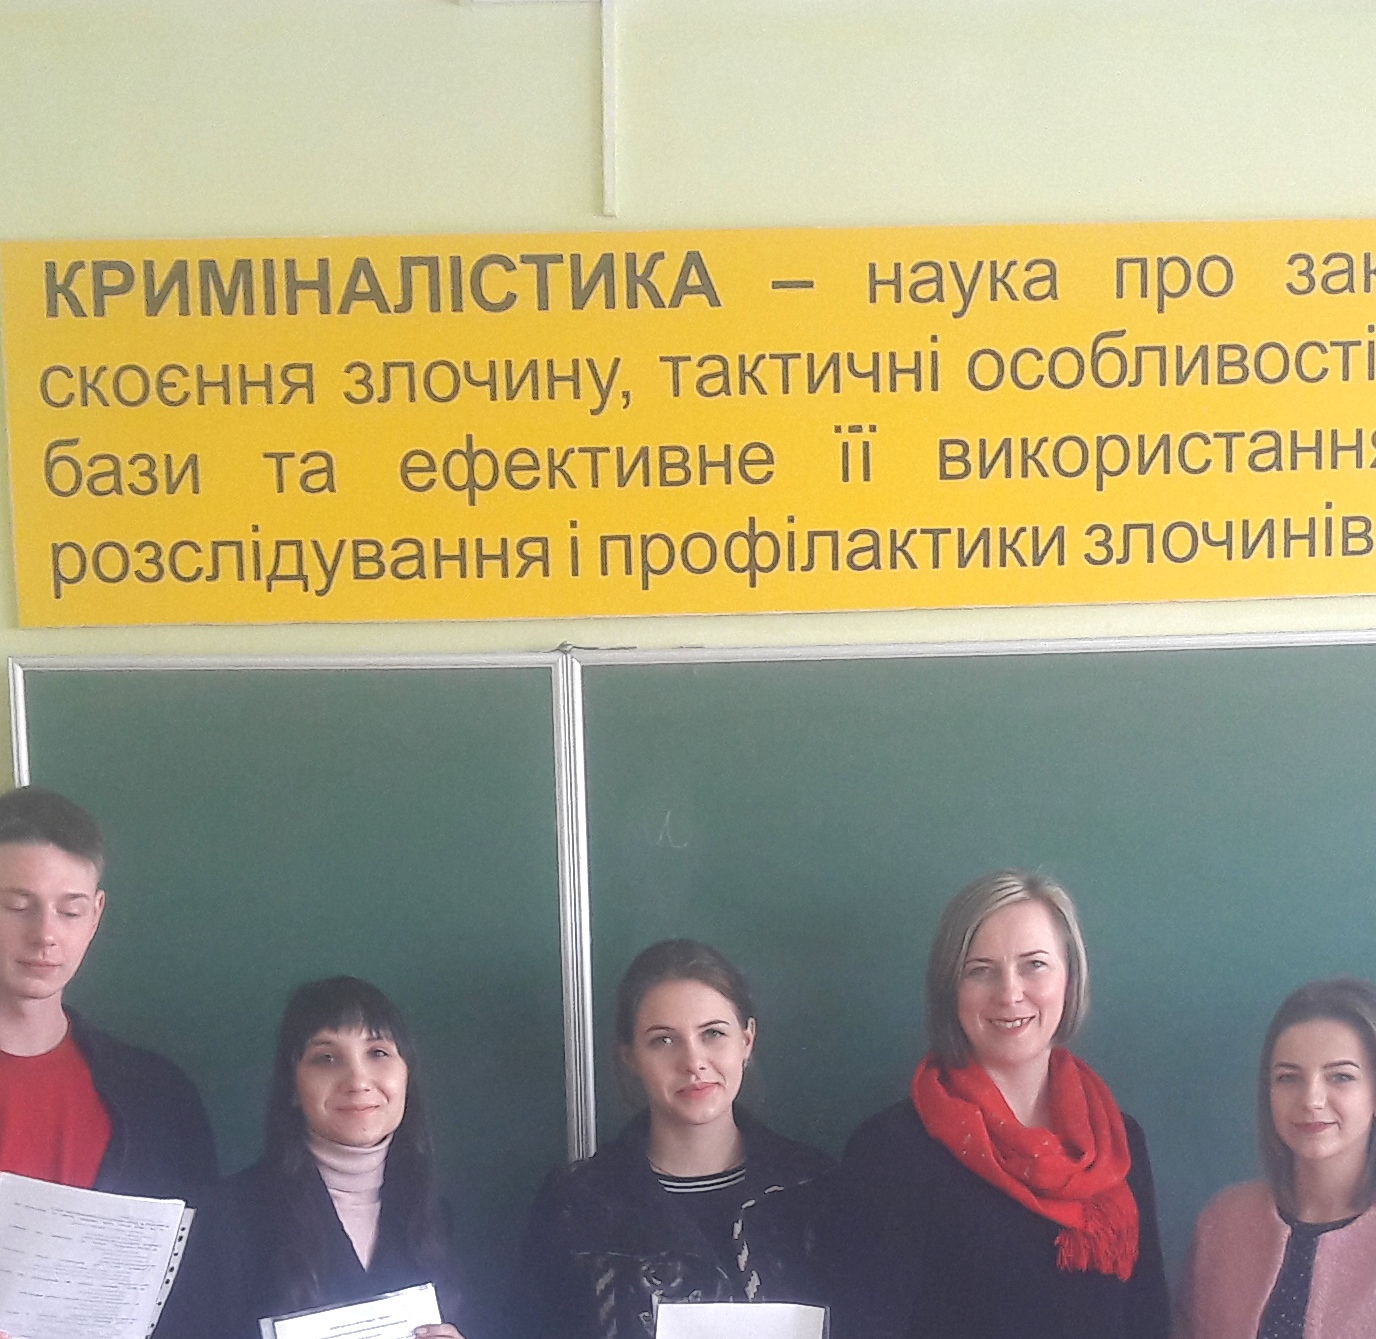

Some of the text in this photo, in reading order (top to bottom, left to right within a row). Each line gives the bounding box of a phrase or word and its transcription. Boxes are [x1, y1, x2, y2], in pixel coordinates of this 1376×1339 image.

[44, 250, 723, 319] КРИМІНАЛІСТИКА
[868, 258, 1060, 320] наука
[1115, 254, 1234, 315] про
[39, 362, 315, 409] скоєння
[342, 356, 631, 417] злочину,
[658, 334, 939, 398] тактичні
[967, 323, 1376, 392] особливості
[43, 437, 200, 498] бази
[261, 450, 337, 494] та
[399, 433, 775, 507] ефективне
[833, 423, 878, 483] її
[51, 523, 550, 600] розслідування
[569, 519, 580, 577] і
[599, 514, 1066, 591] профілактики
